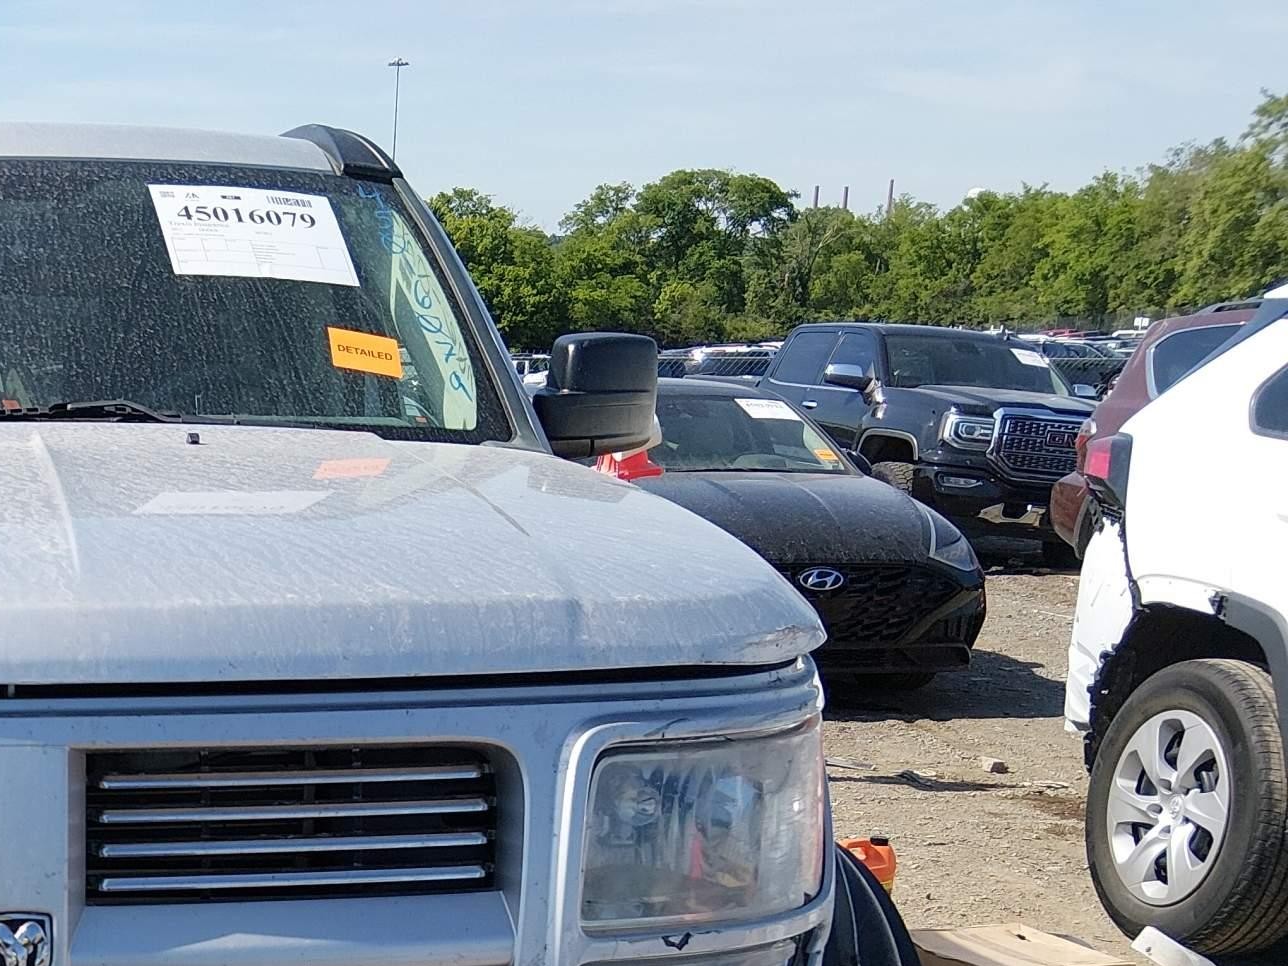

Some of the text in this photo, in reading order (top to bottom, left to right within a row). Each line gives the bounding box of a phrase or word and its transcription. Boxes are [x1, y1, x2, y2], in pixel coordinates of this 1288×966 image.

[177, 205, 317, 229] 45016079
[337, 343, 393, 362] DETAILED
[1047, 431, 1076, 448] GM
